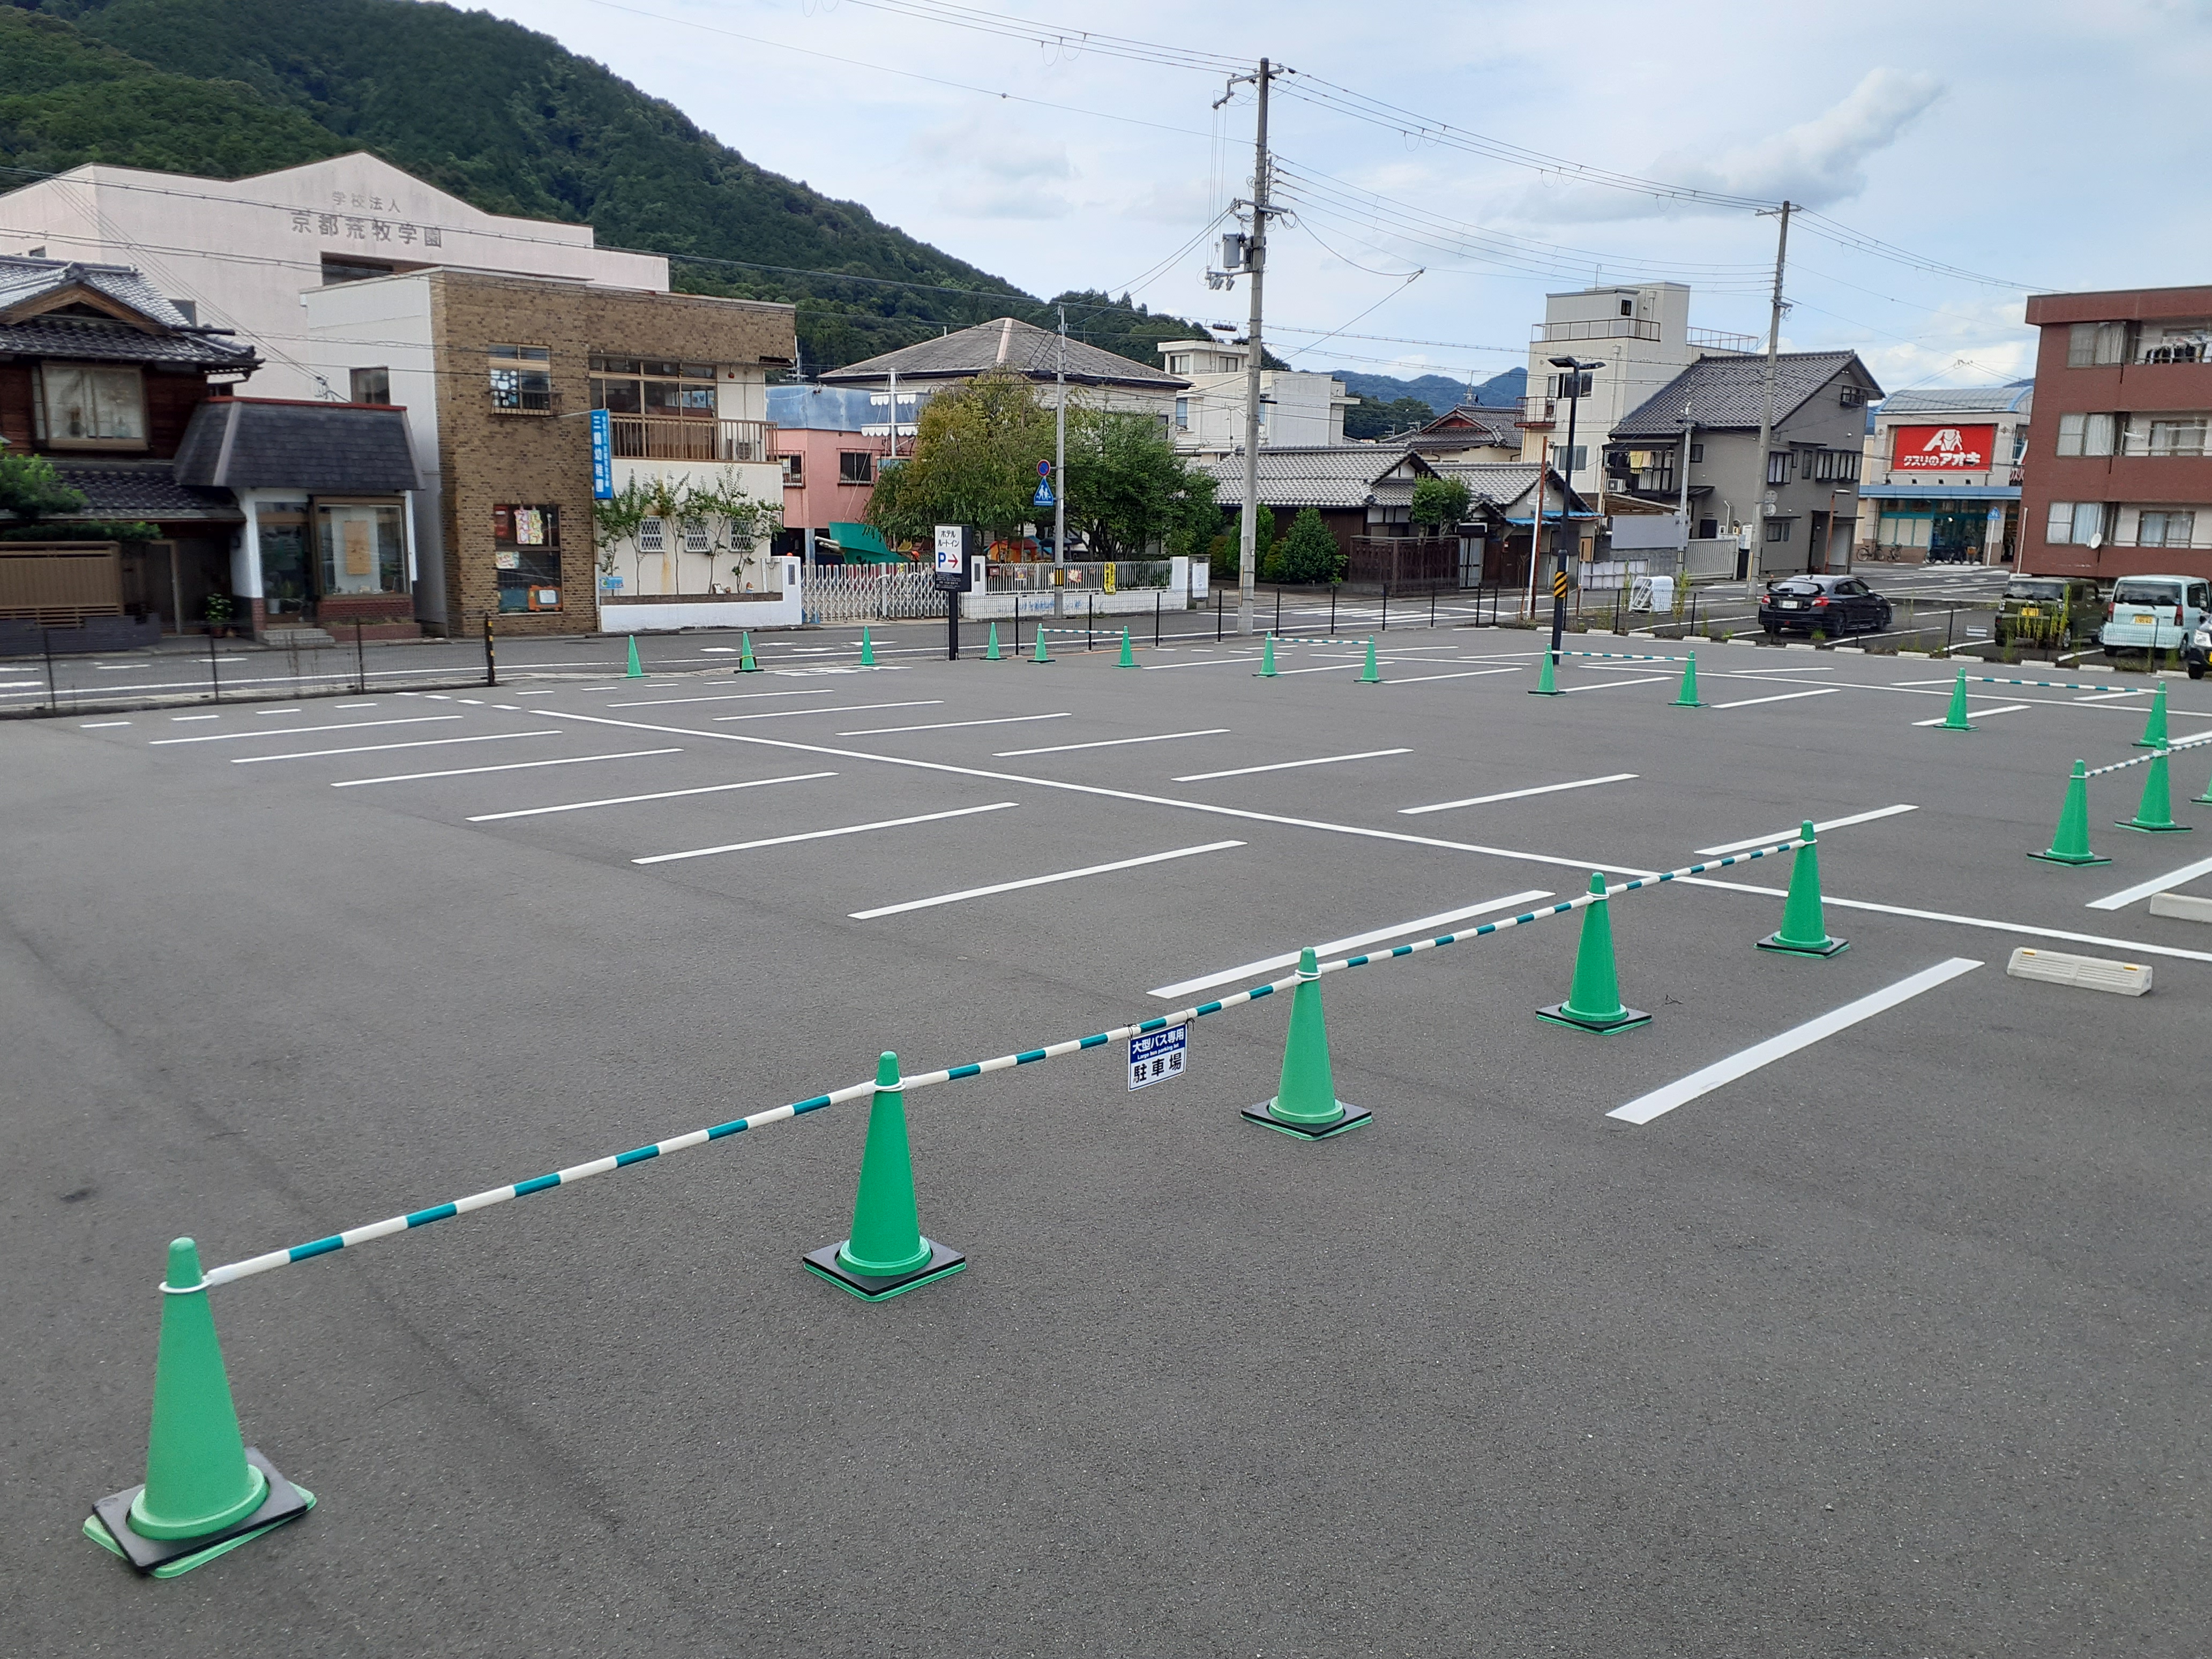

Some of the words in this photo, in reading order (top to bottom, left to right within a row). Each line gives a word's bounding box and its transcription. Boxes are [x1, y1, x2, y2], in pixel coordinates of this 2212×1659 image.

[332, 191, 400, 213] 学校法人
[938, 539, 959, 548] ルートイン
[940, 530, 956, 538] ホテル
[938, 552, 946, 569] P
[1132, 1028, 1184, 1055] 大型バス専用
[1133, 1052, 1182, 1083] 駐車場
